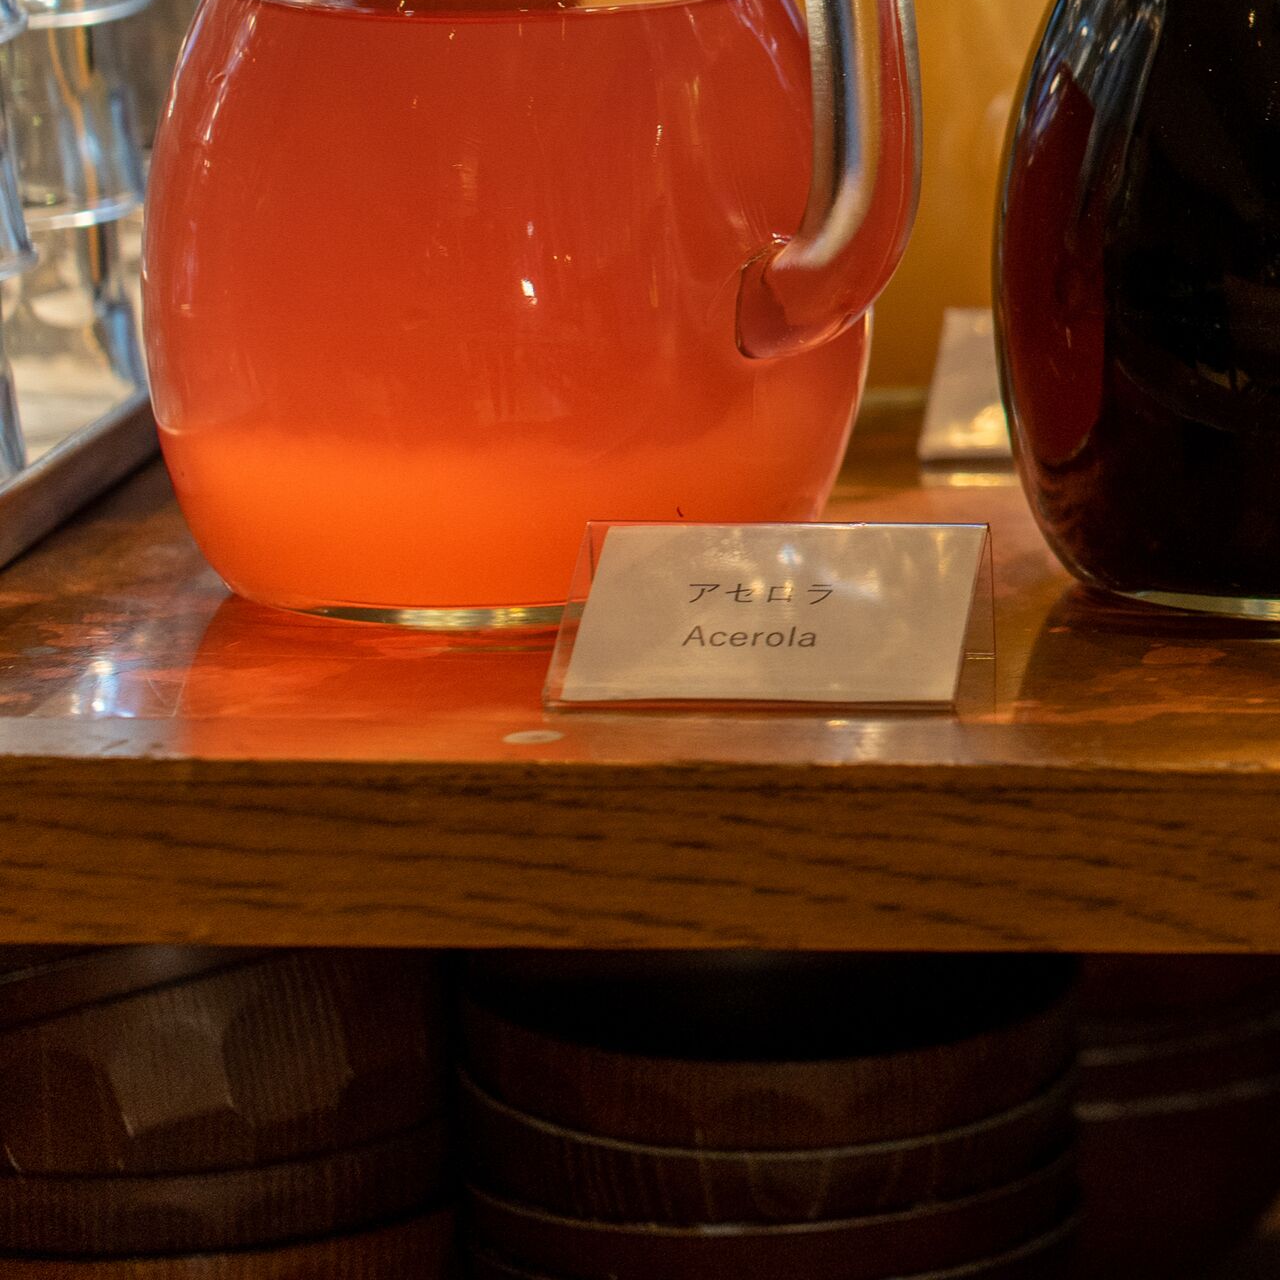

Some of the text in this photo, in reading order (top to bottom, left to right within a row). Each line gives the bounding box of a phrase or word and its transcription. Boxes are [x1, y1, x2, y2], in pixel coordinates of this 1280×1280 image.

[688, 582, 834, 606] アセロラ
[682, 625, 818, 649] Acerola
